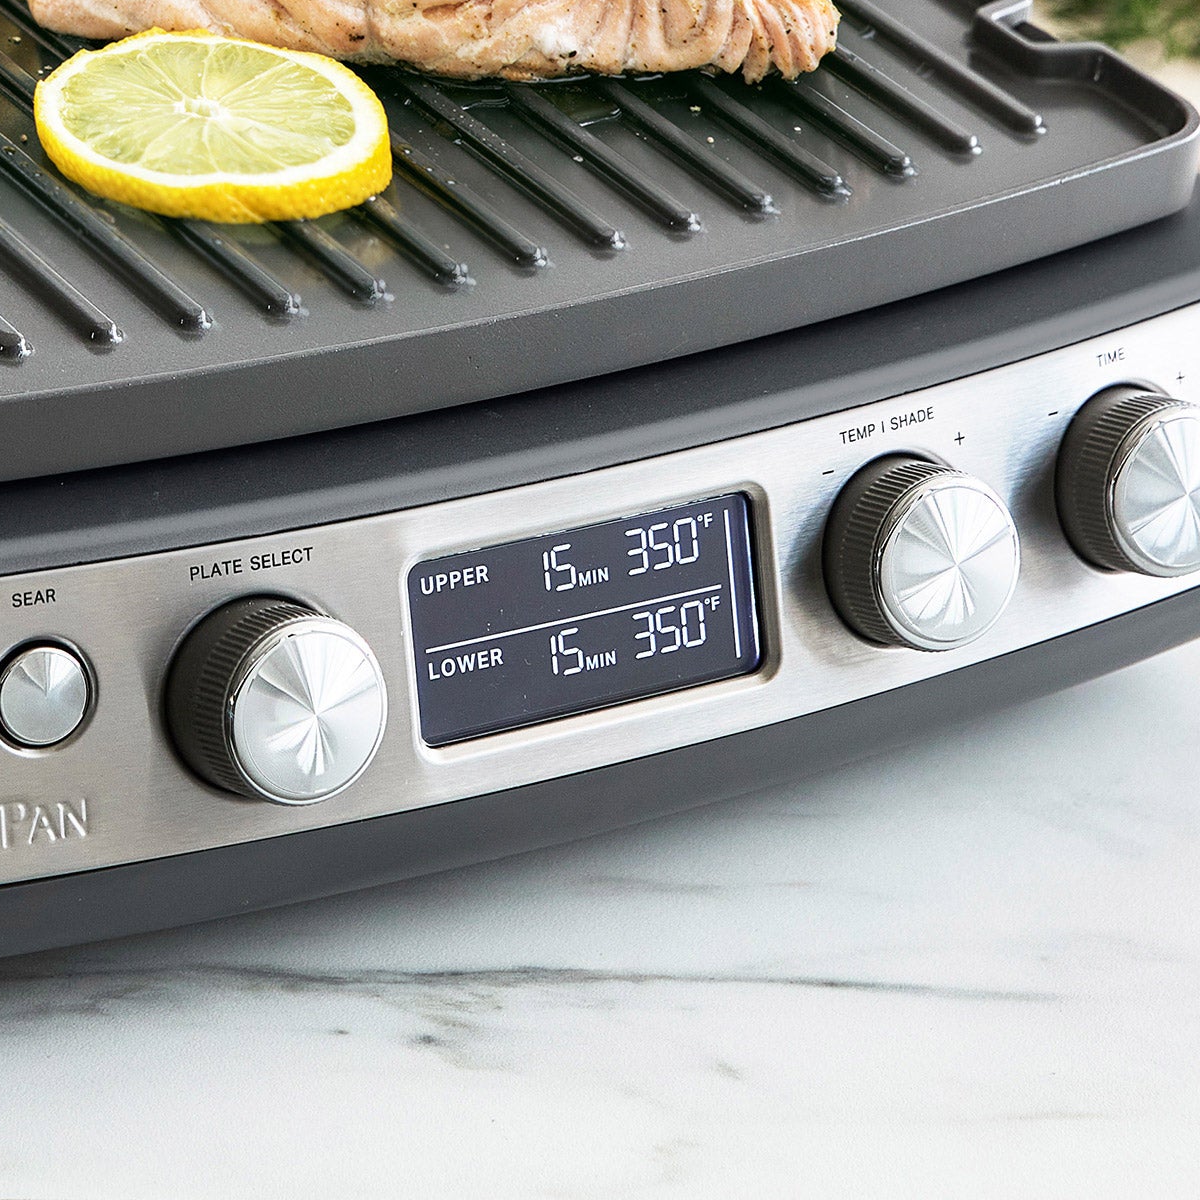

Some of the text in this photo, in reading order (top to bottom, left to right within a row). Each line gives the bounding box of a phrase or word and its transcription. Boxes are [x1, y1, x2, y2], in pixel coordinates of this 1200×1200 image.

[1097, 347, 1125, 367] TIME
[839, 422, 876, 445] TEMP
[890, 406, 935, 430] SHADE
[189, 547, 313, 580] PLATE SELECT
[420, 565, 490, 595] UPPER
[11, 588, 56, 607] SEAR
[428, 648, 504, 680] LOWER
